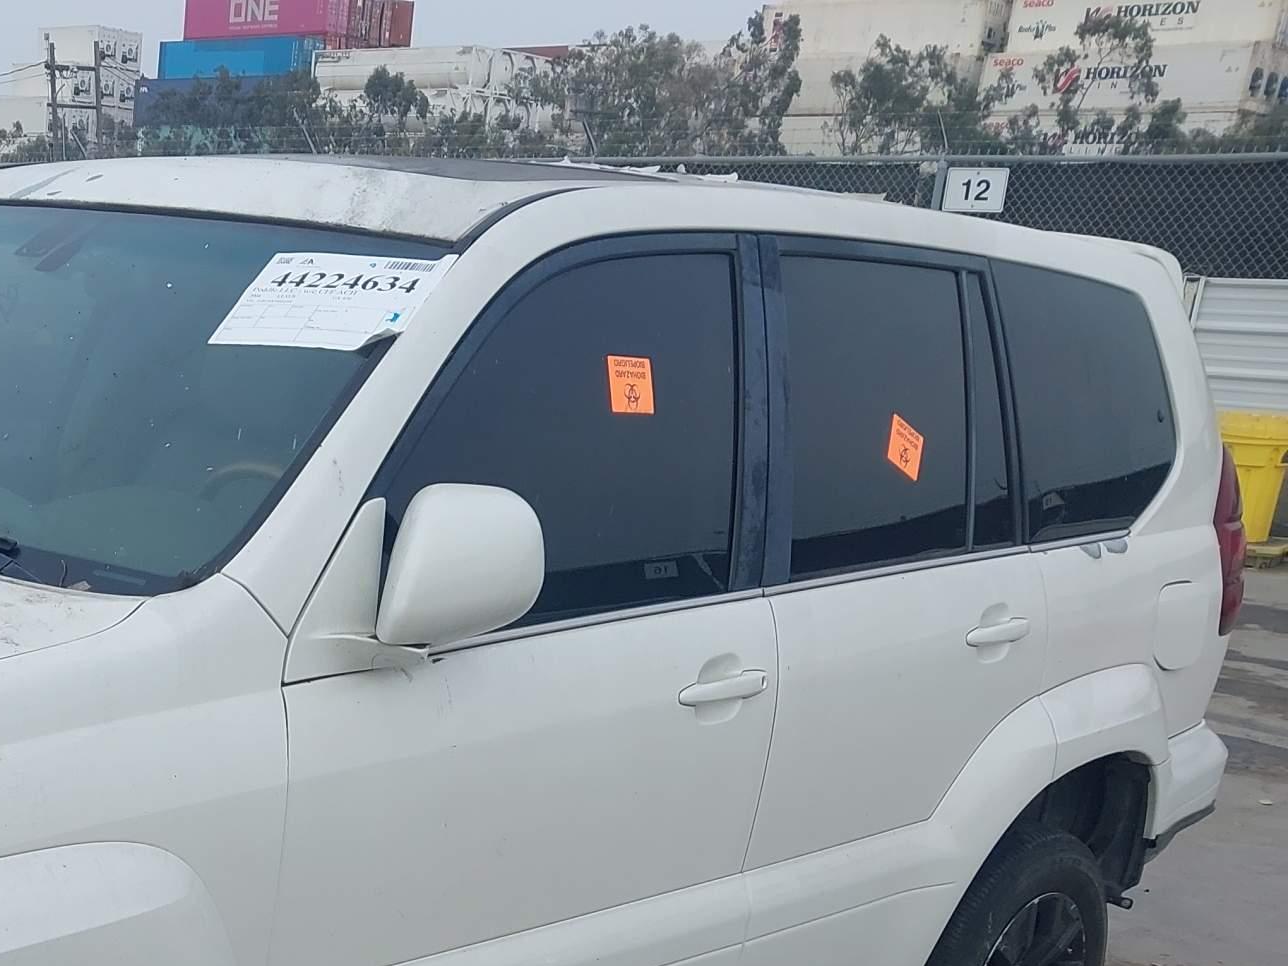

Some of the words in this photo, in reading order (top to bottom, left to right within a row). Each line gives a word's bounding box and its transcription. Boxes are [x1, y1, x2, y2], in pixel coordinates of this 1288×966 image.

[228, 0, 279, 23] ONE
[1116, 0, 1200, 18] HORIZON
[992, 57, 1024, 67] seaco
[1085, 64, 1168, 80] HORIZON
[961, 178, 991, 201] 12
[270, 271, 421, 294] 44224634
